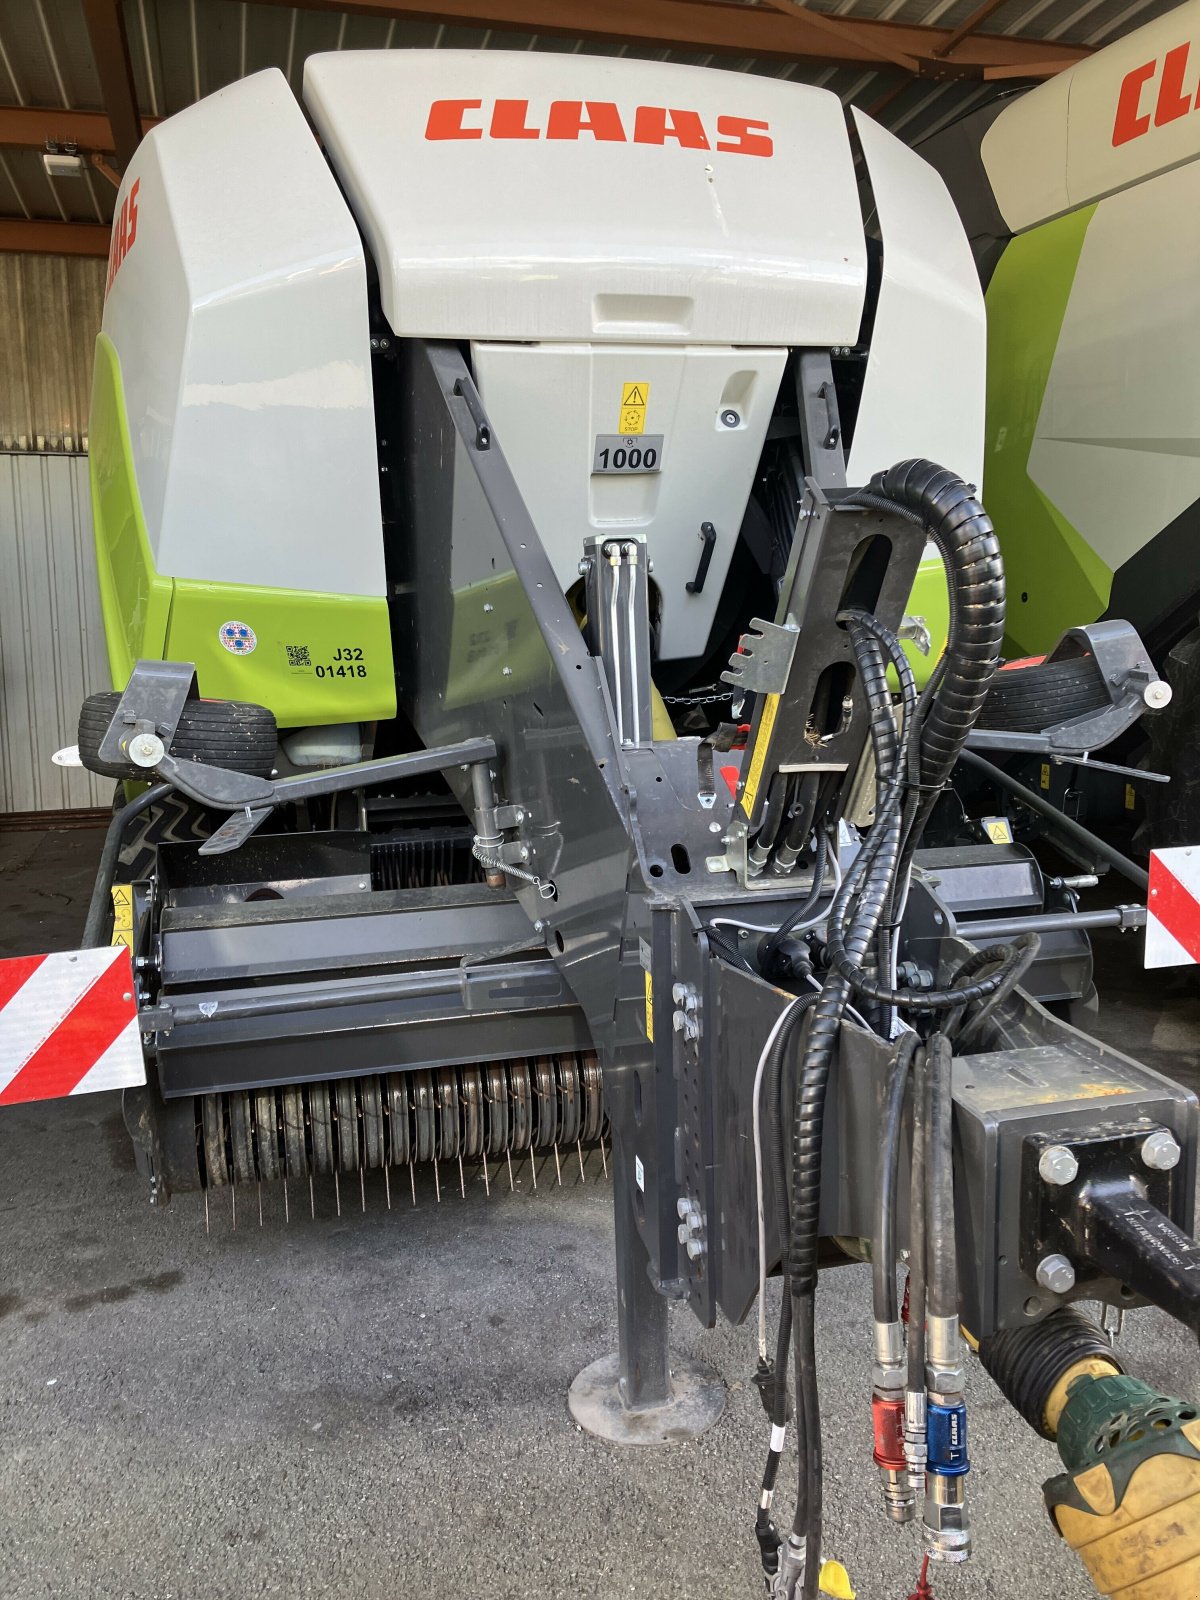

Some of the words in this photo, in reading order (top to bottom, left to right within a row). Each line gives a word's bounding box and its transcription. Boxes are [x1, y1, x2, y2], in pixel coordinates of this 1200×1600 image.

[1111, 40, 1200, 148] CL
[424, 98, 774, 158] CLAAS
[599, 448, 657, 468] 1000
[332, 648, 364, 661] J32
[315, 665, 367, 678] 01418
